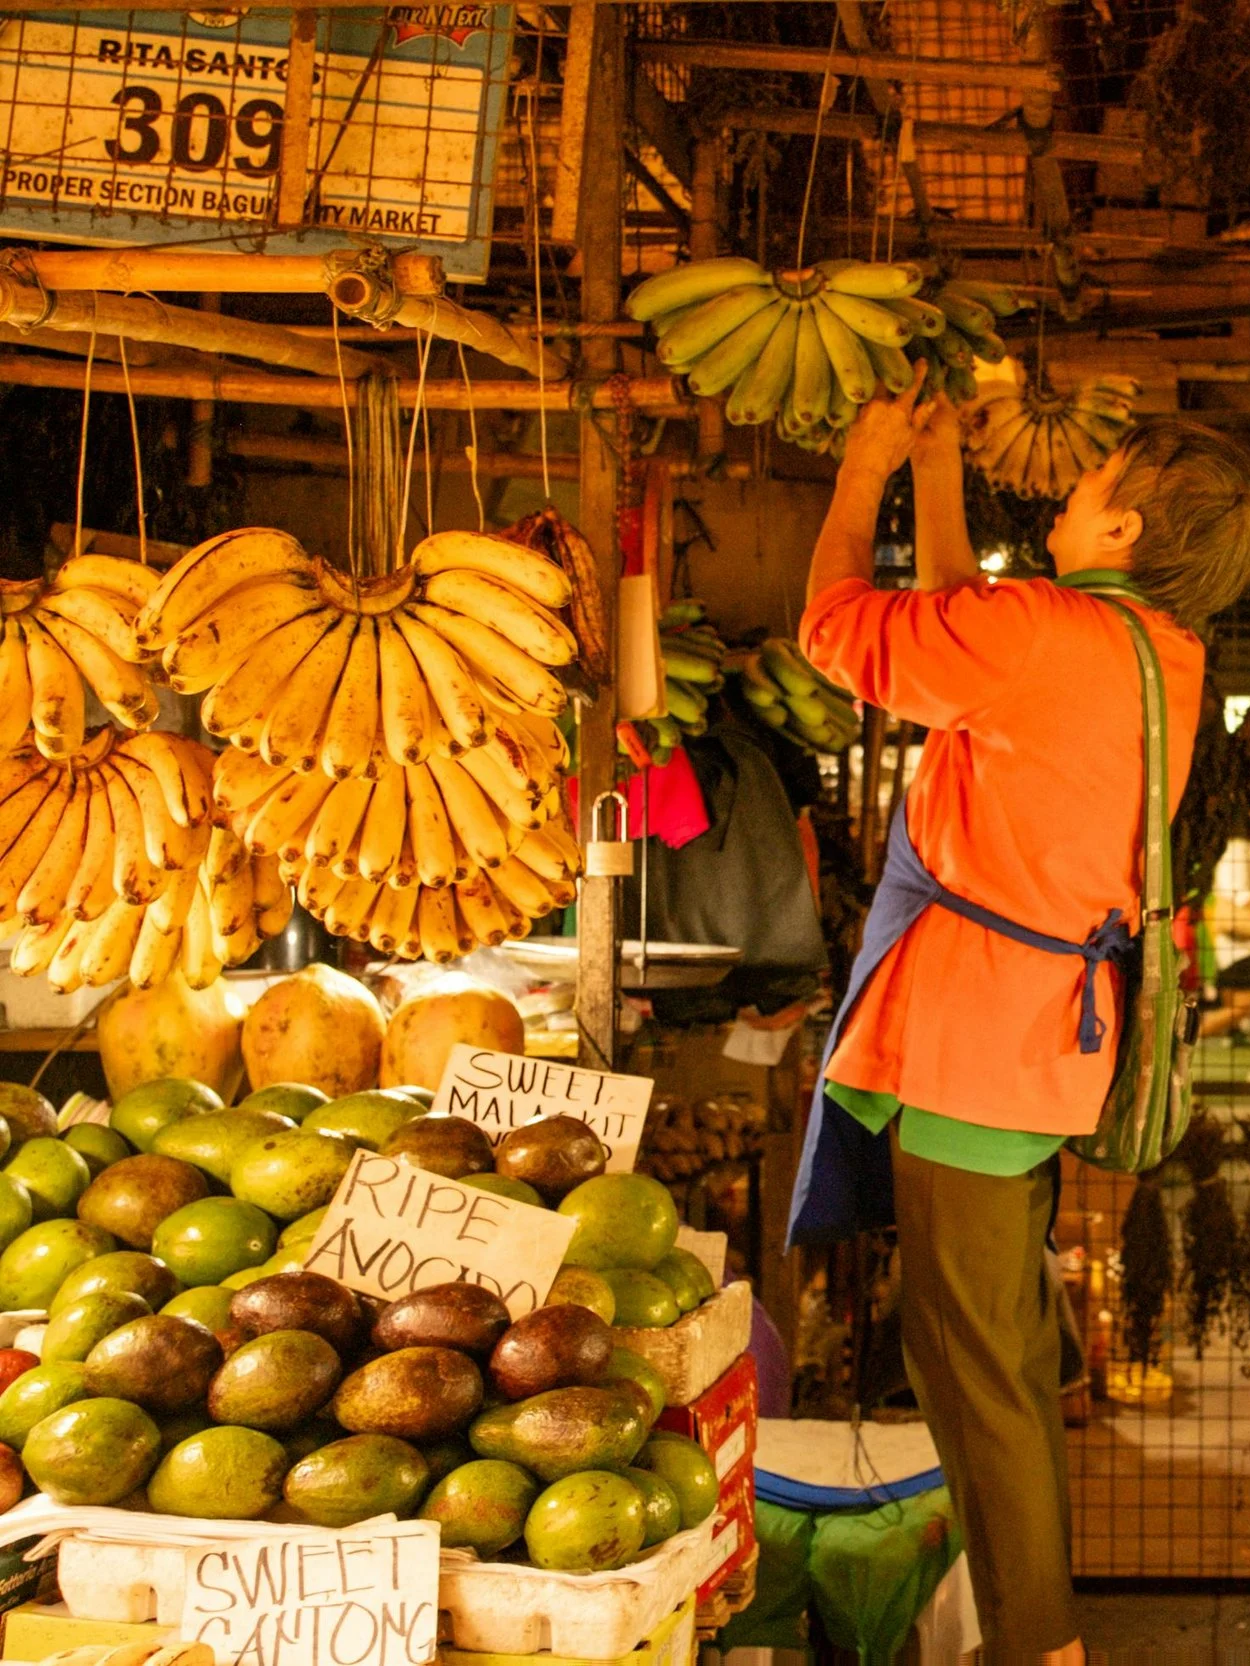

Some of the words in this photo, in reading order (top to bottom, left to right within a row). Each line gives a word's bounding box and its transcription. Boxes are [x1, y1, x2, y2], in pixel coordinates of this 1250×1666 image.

[98, 38, 175, 70] RITA
[104, 85, 286, 179] 309
[4, 169, 94, 198] PROPER
[99, 179, 196, 209] SECTION
[201, 190, 278, 217] BAGU
[349, 207, 442, 234] MARKET
[454, 1052, 626, 1105] SWEET
[449, 1086, 637, 1138] MALKIT
[343, 1153, 510, 1244] RIPE
[194, 1533, 425, 1613] SWEET
